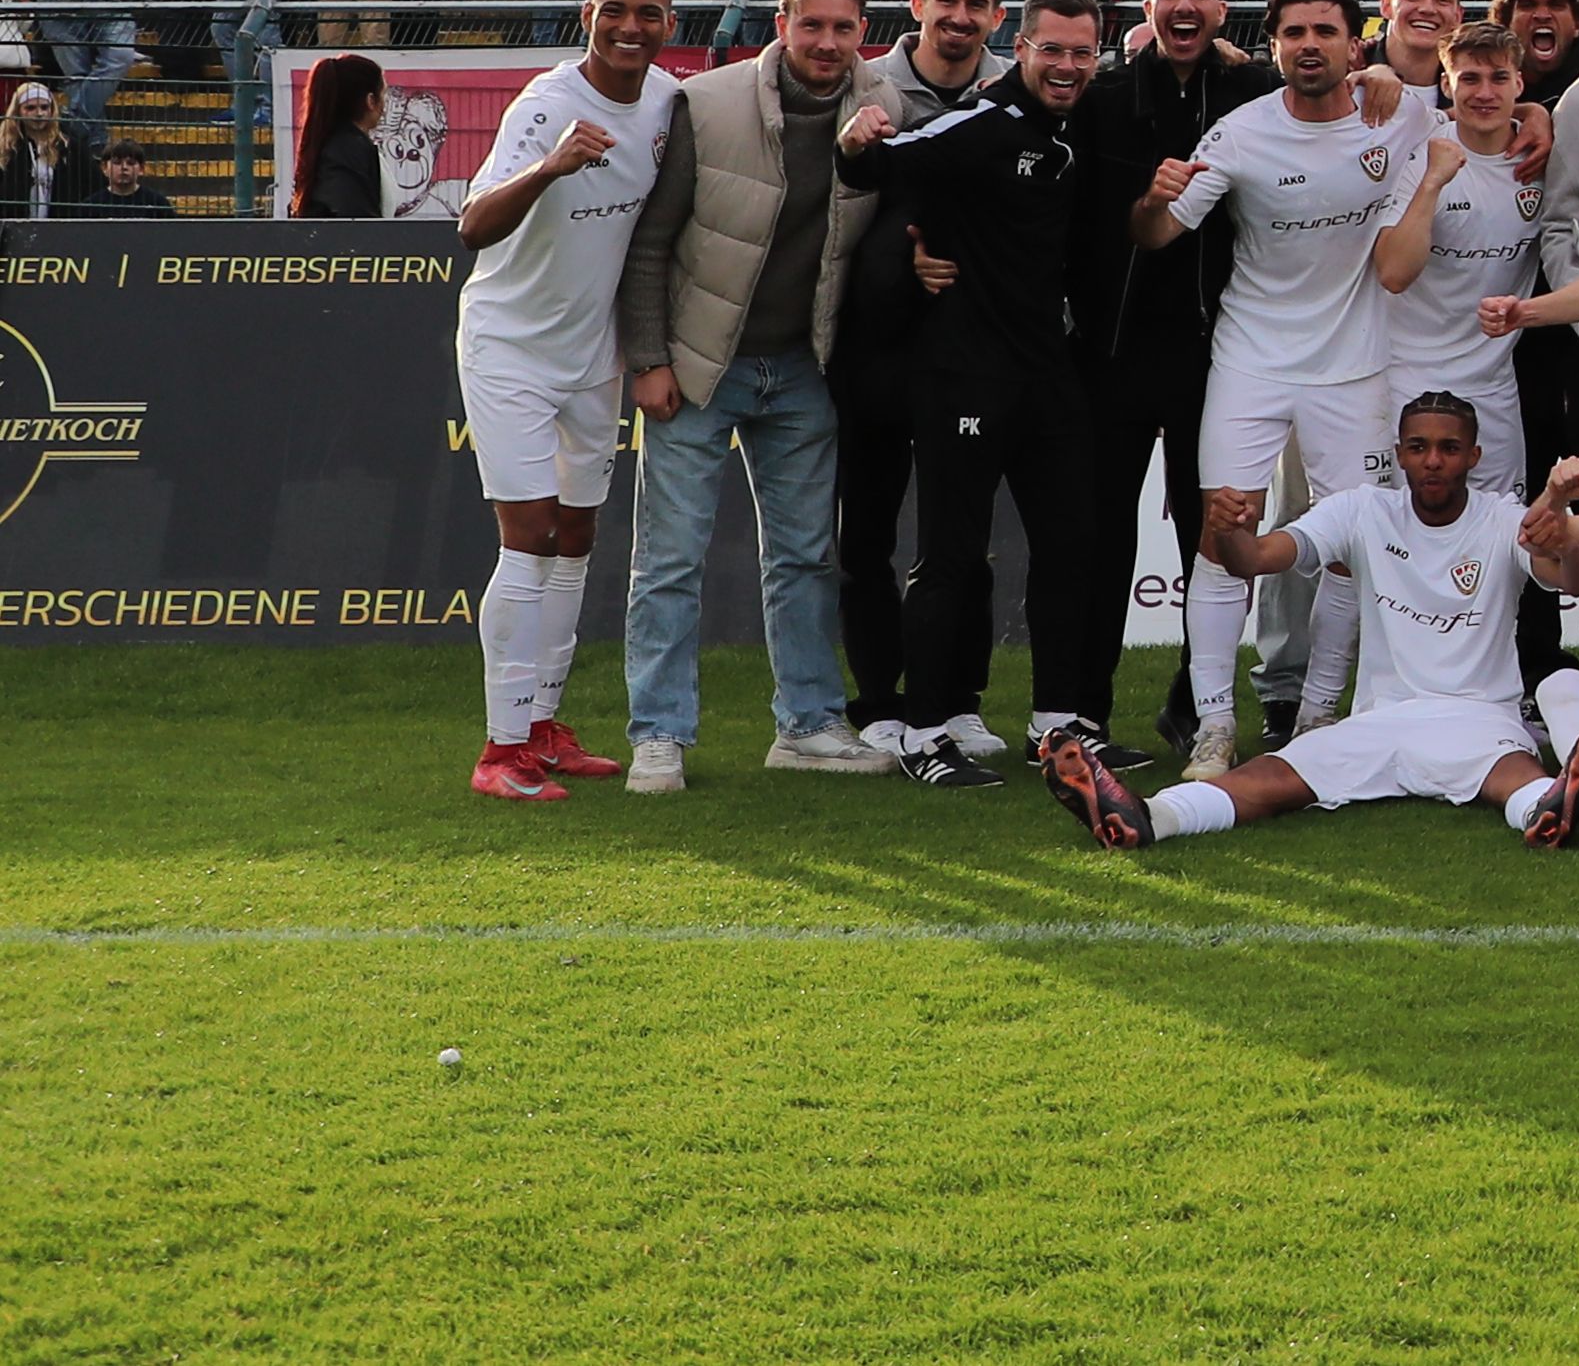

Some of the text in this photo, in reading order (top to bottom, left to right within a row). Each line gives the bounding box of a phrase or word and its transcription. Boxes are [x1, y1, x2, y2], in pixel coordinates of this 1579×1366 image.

[586, 159, 609, 170] AKO
[1017, 159, 1034, 177] PK
[1278, 175, 1306, 187] JAKO
[1446, 202, 1471, 212] JAKO
[157, 256, 452, 284] BETRIEBSFEIERN
[959, 417, 980, 436] PK
[1365, 452, 1392, 472] DW
[1385, 543, 1409, 561] JAKO
[340, 589, 477, 625] BEILA
[1198, 696, 1226, 707] JAKO
